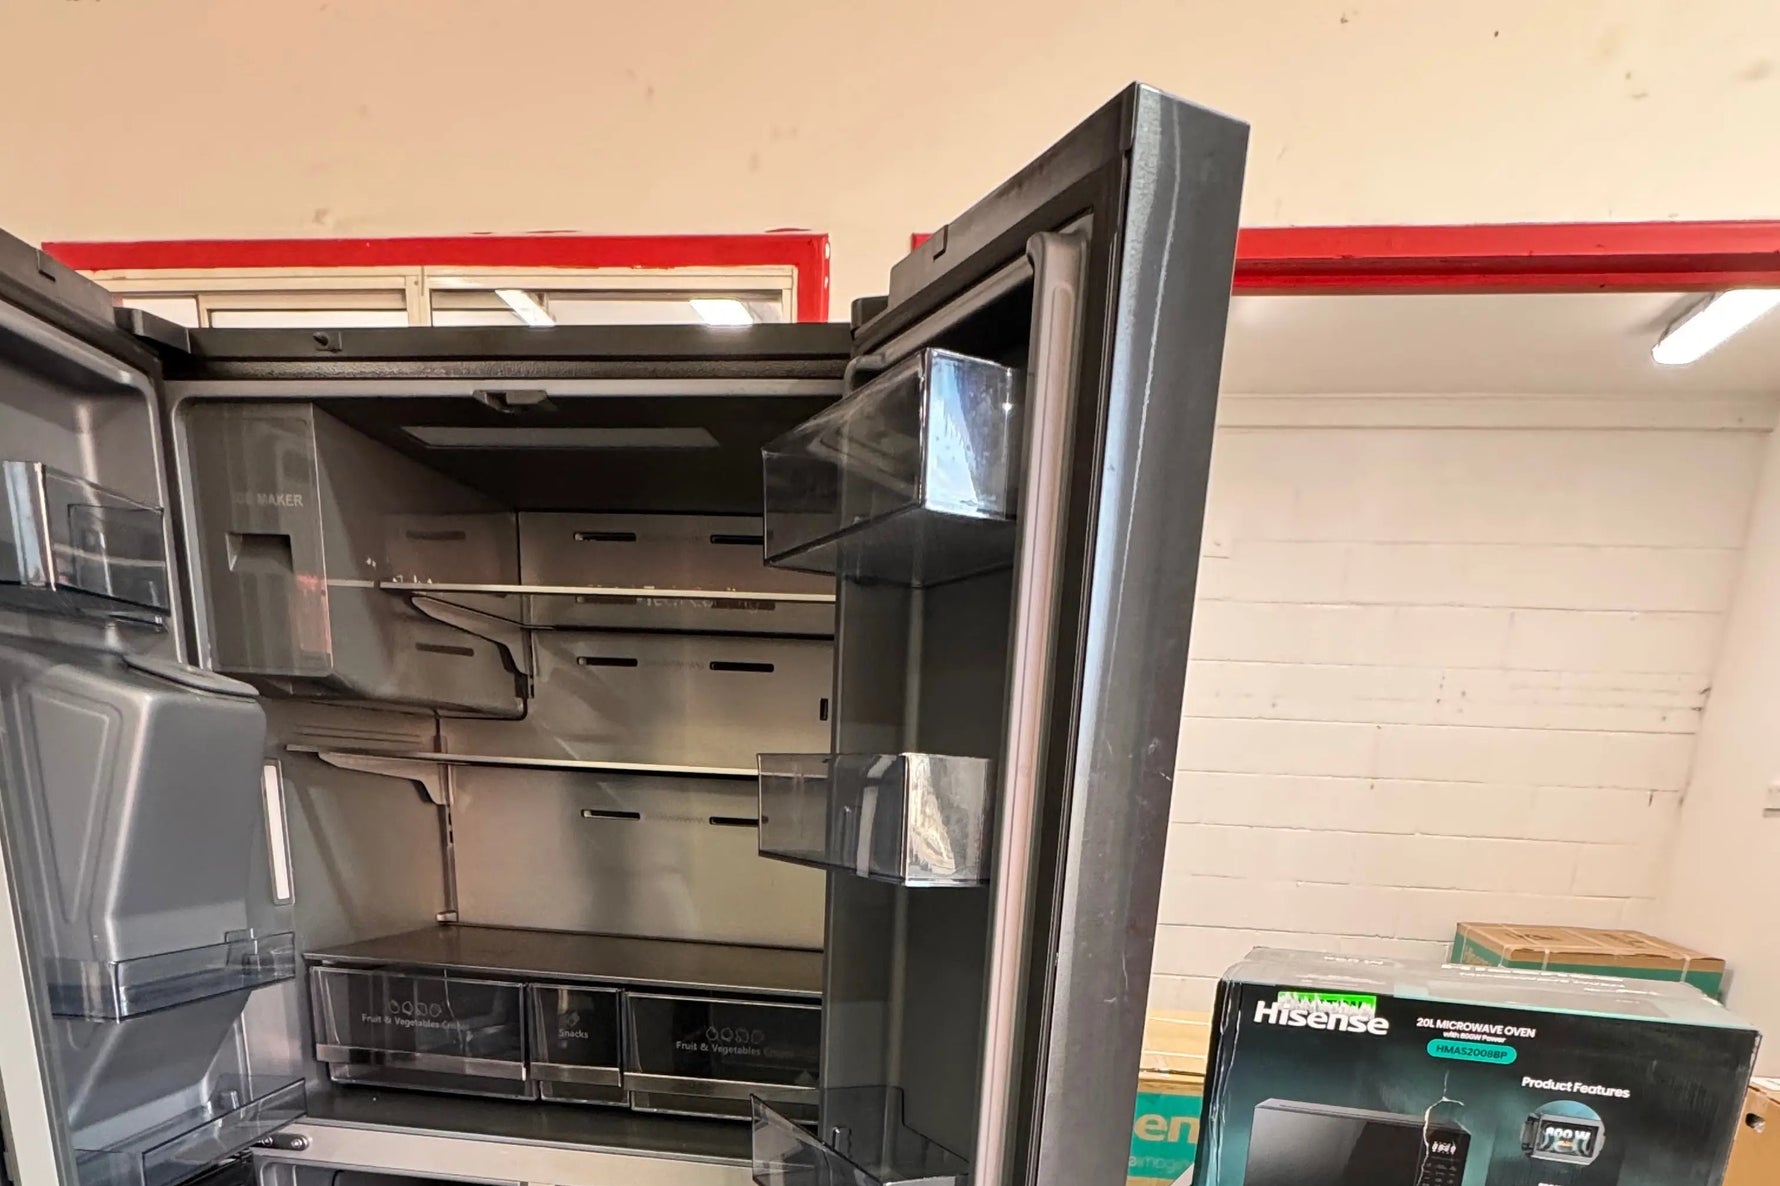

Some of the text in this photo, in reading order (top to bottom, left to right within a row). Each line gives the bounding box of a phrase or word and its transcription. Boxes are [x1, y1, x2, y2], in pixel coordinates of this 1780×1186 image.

[256, 492, 303, 507] MAKER
[361, 1013, 382, 1024] Fruit
[394, 1016, 440, 1028] Vegetables
[1253, 1000, 1390, 1036] Hisense
[1416, 1017, 1537, 1038] 20L MICROWAVE OVEN
[558, 1028, 589, 1039] Snacks
[675, 1040, 698, 1051] Fruit
[711, 1044, 761, 1057] Vegetables
[1521, 1076, 1631, 1098] Product Features
[1134, 1113, 1200, 1144] en
